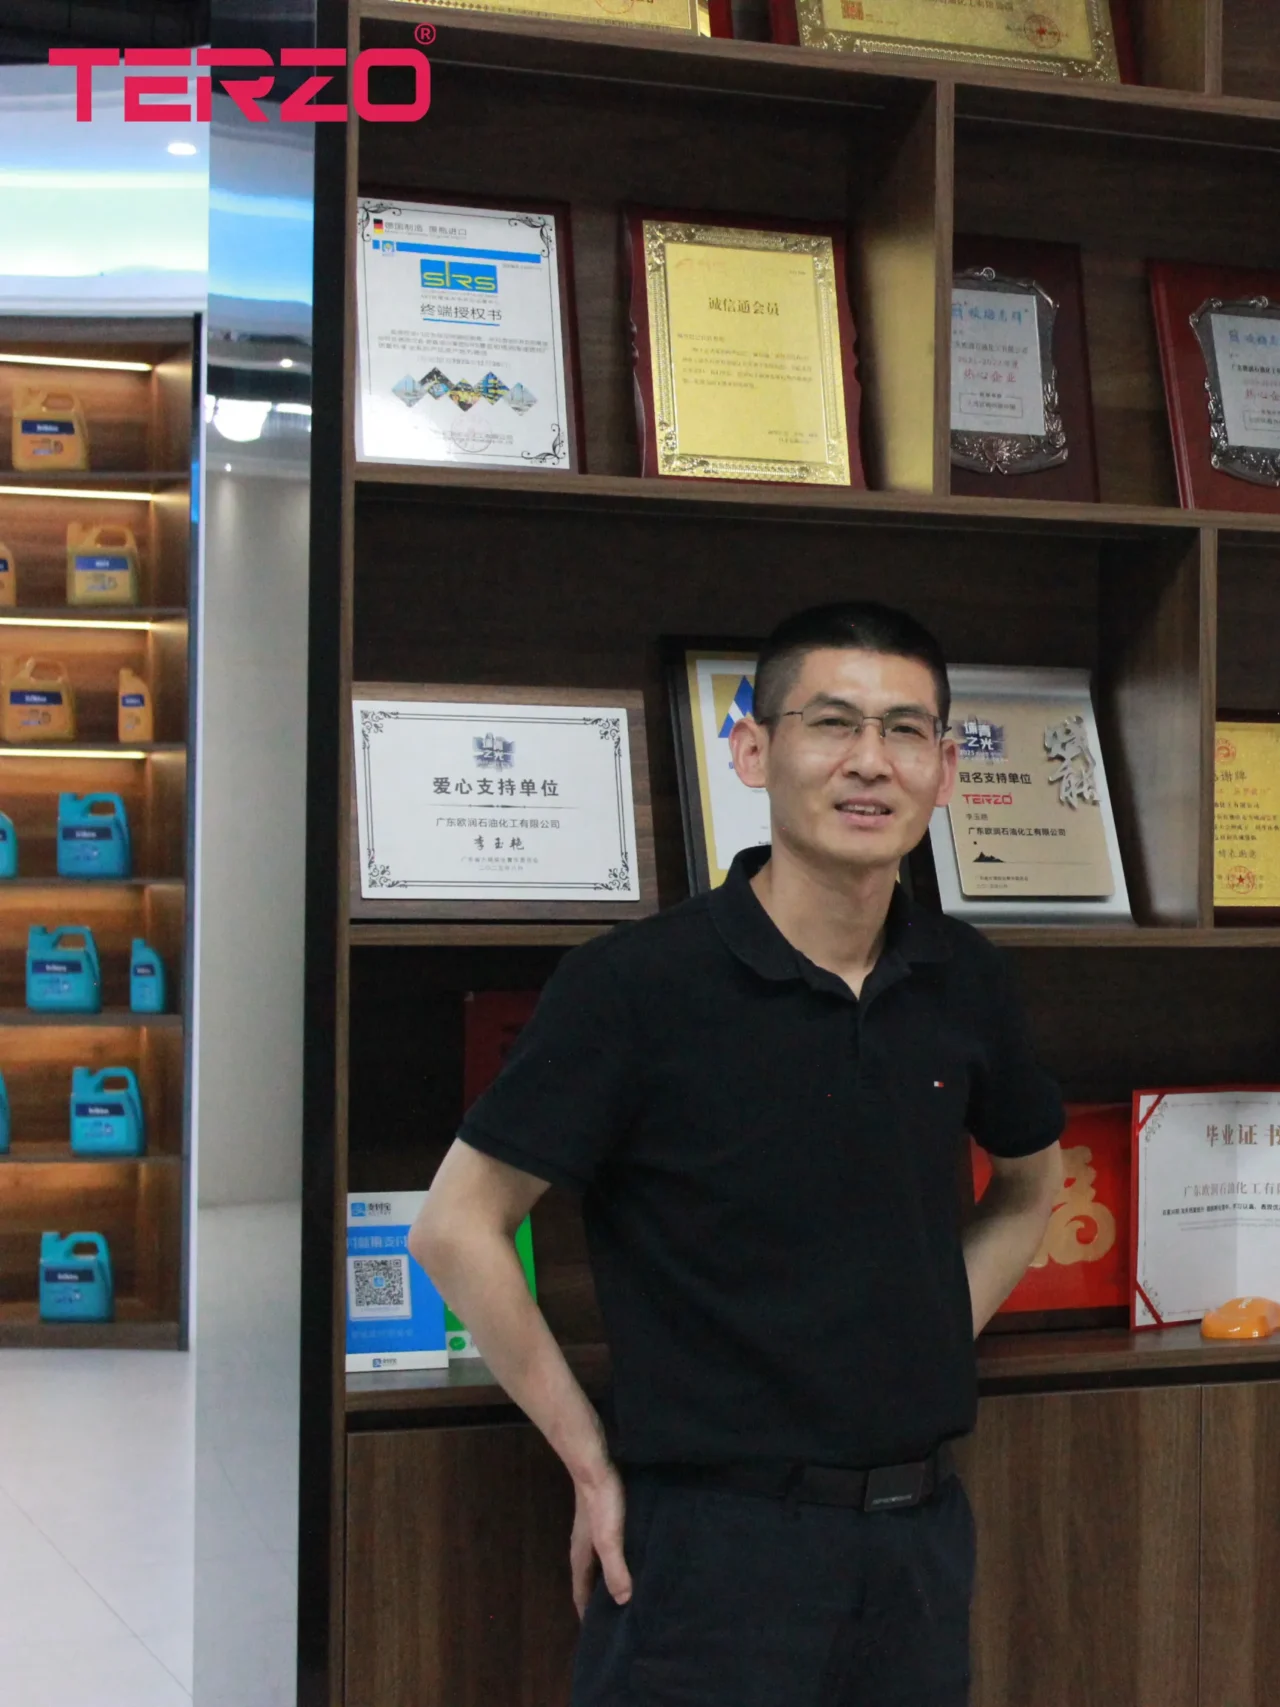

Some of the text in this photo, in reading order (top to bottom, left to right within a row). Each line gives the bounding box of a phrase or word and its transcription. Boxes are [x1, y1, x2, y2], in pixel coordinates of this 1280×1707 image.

[420, 303, 502, 322] 终端授权书
[708, 297, 780, 316] 诚信通会员
[959, 772, 1032, 785] 冠名支持单位
[1214, 770, 1247, 783] 谢牌
[432, 777, 560, 797] 爱心支持单位
[435, 817, 560, 830] 广东欧润石油化工有限公司
[968, 826, 1066, 837] 广东欧润石油化工有限公司
